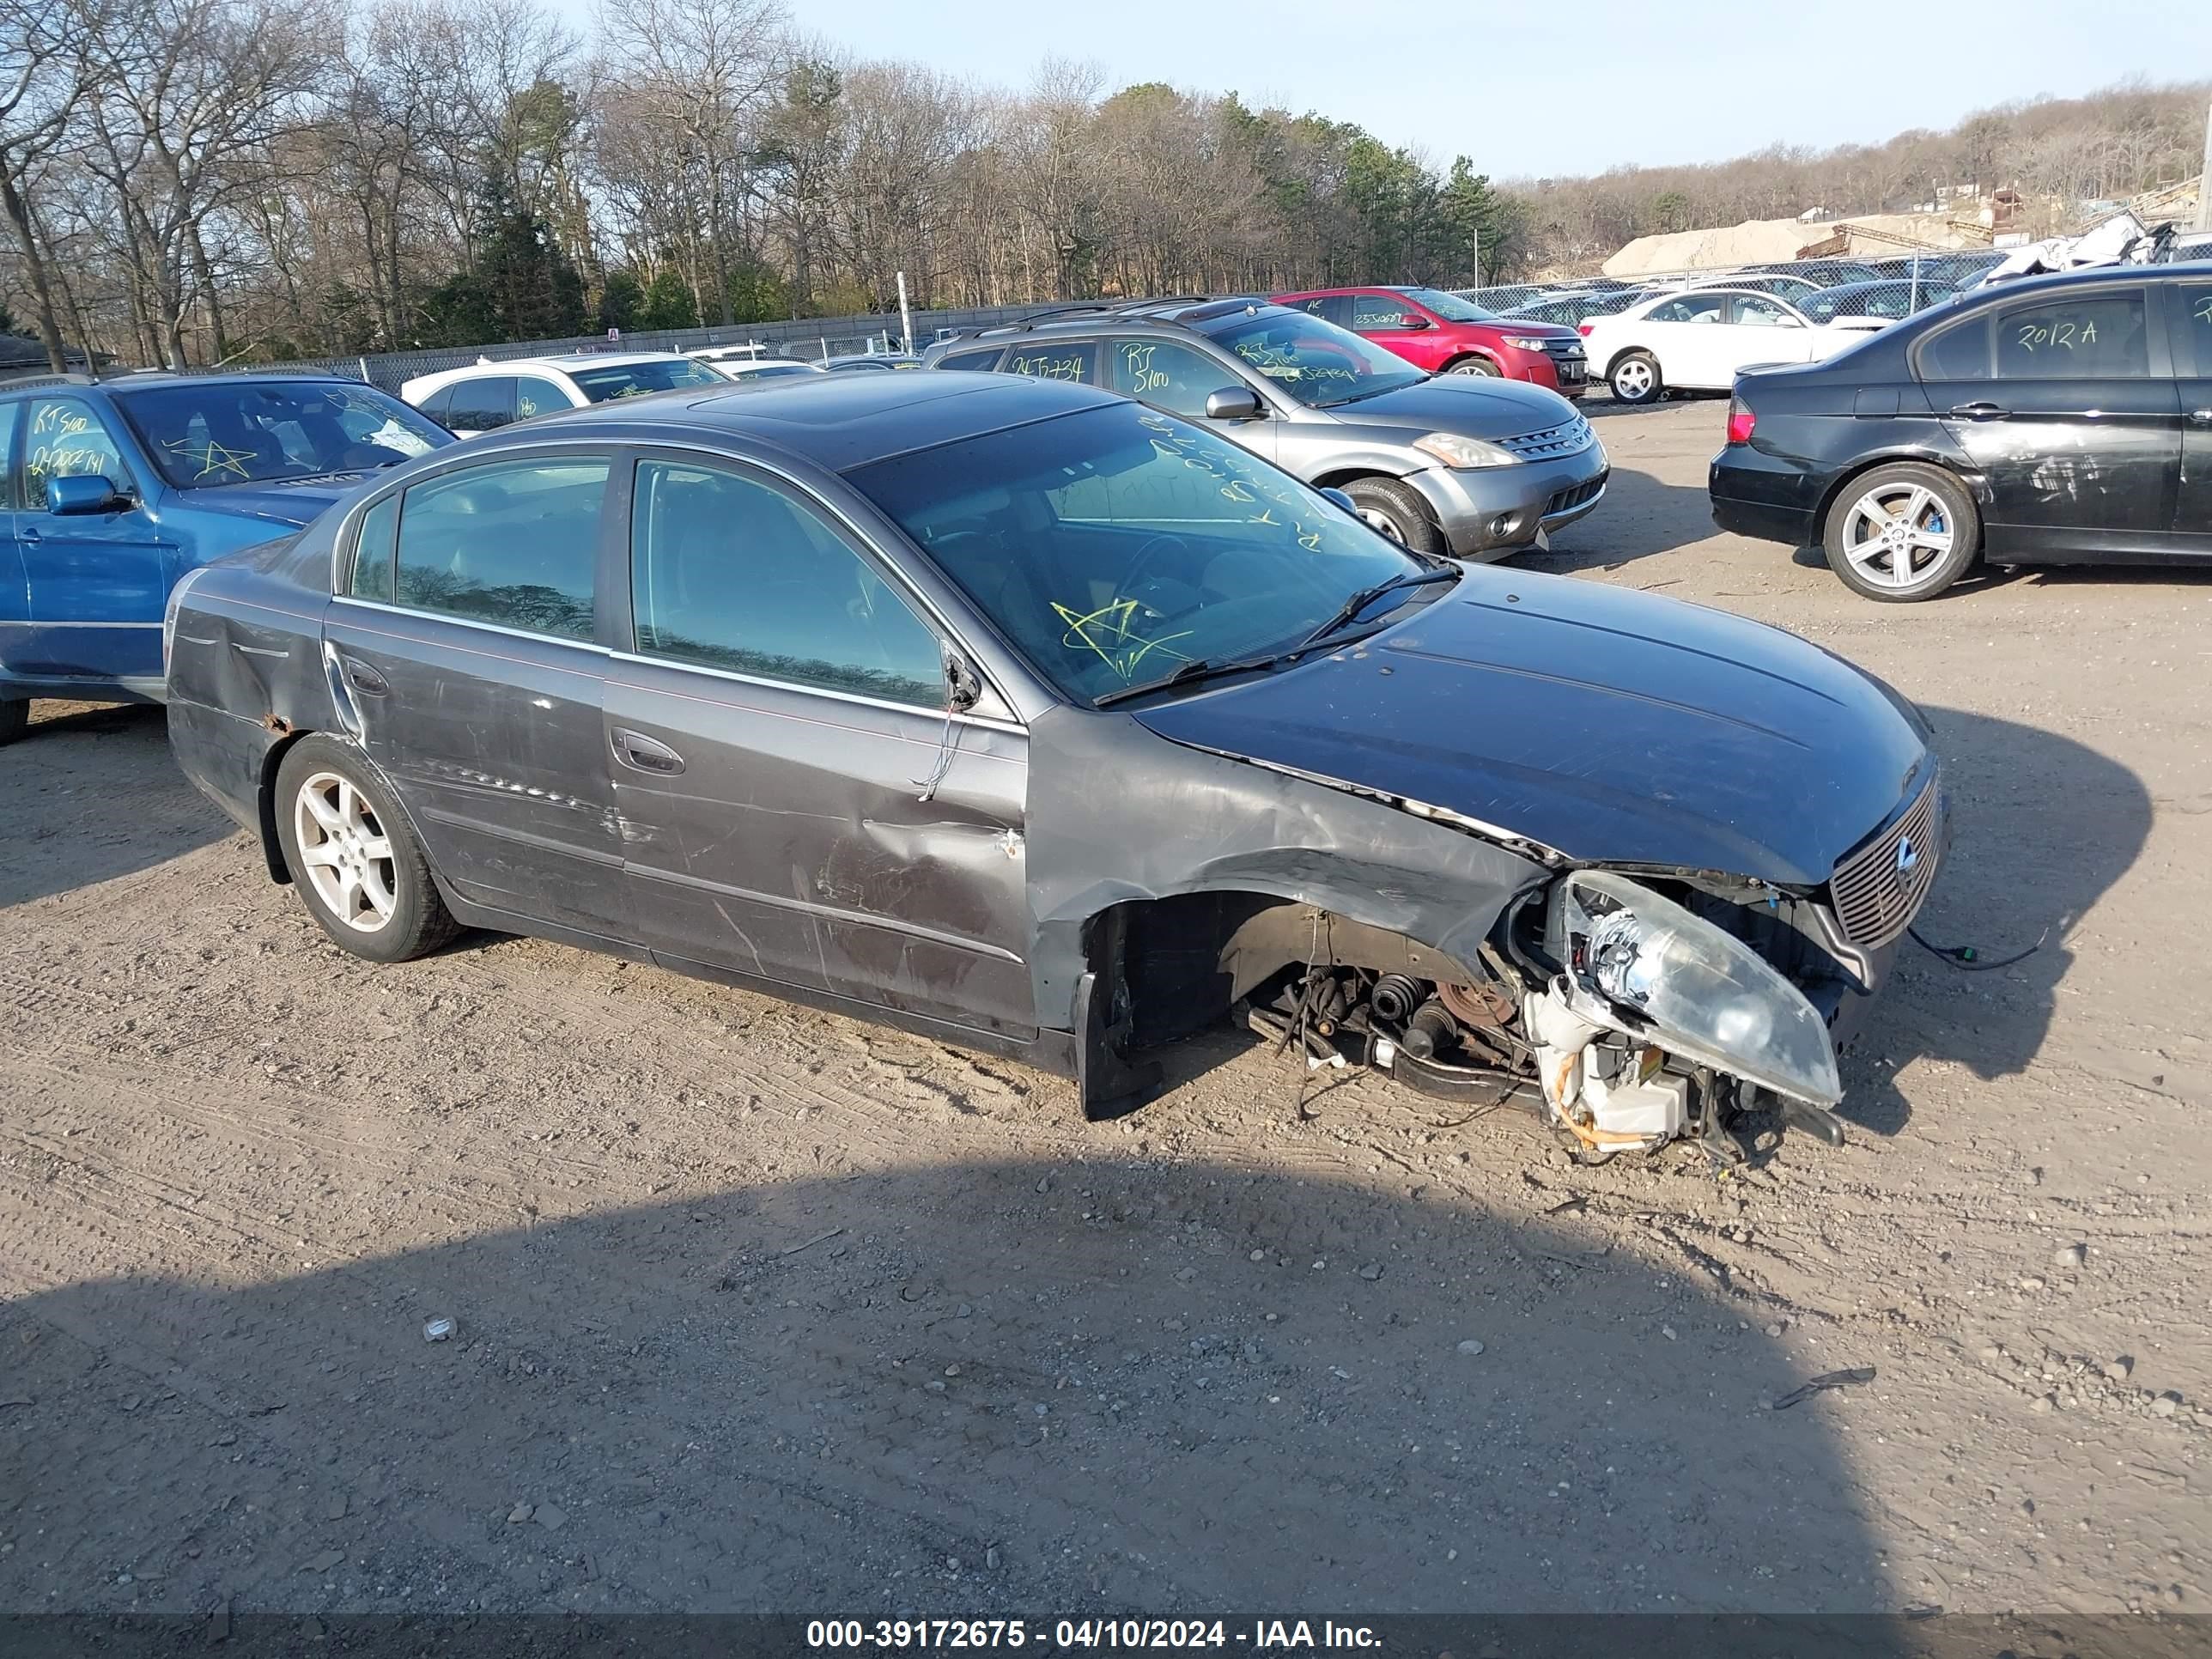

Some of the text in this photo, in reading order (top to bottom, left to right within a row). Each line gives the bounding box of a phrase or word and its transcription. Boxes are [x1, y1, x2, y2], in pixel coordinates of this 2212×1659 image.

[609, 329, 617, 340] A
[2018, 320, 2098, 351] 2012 A
